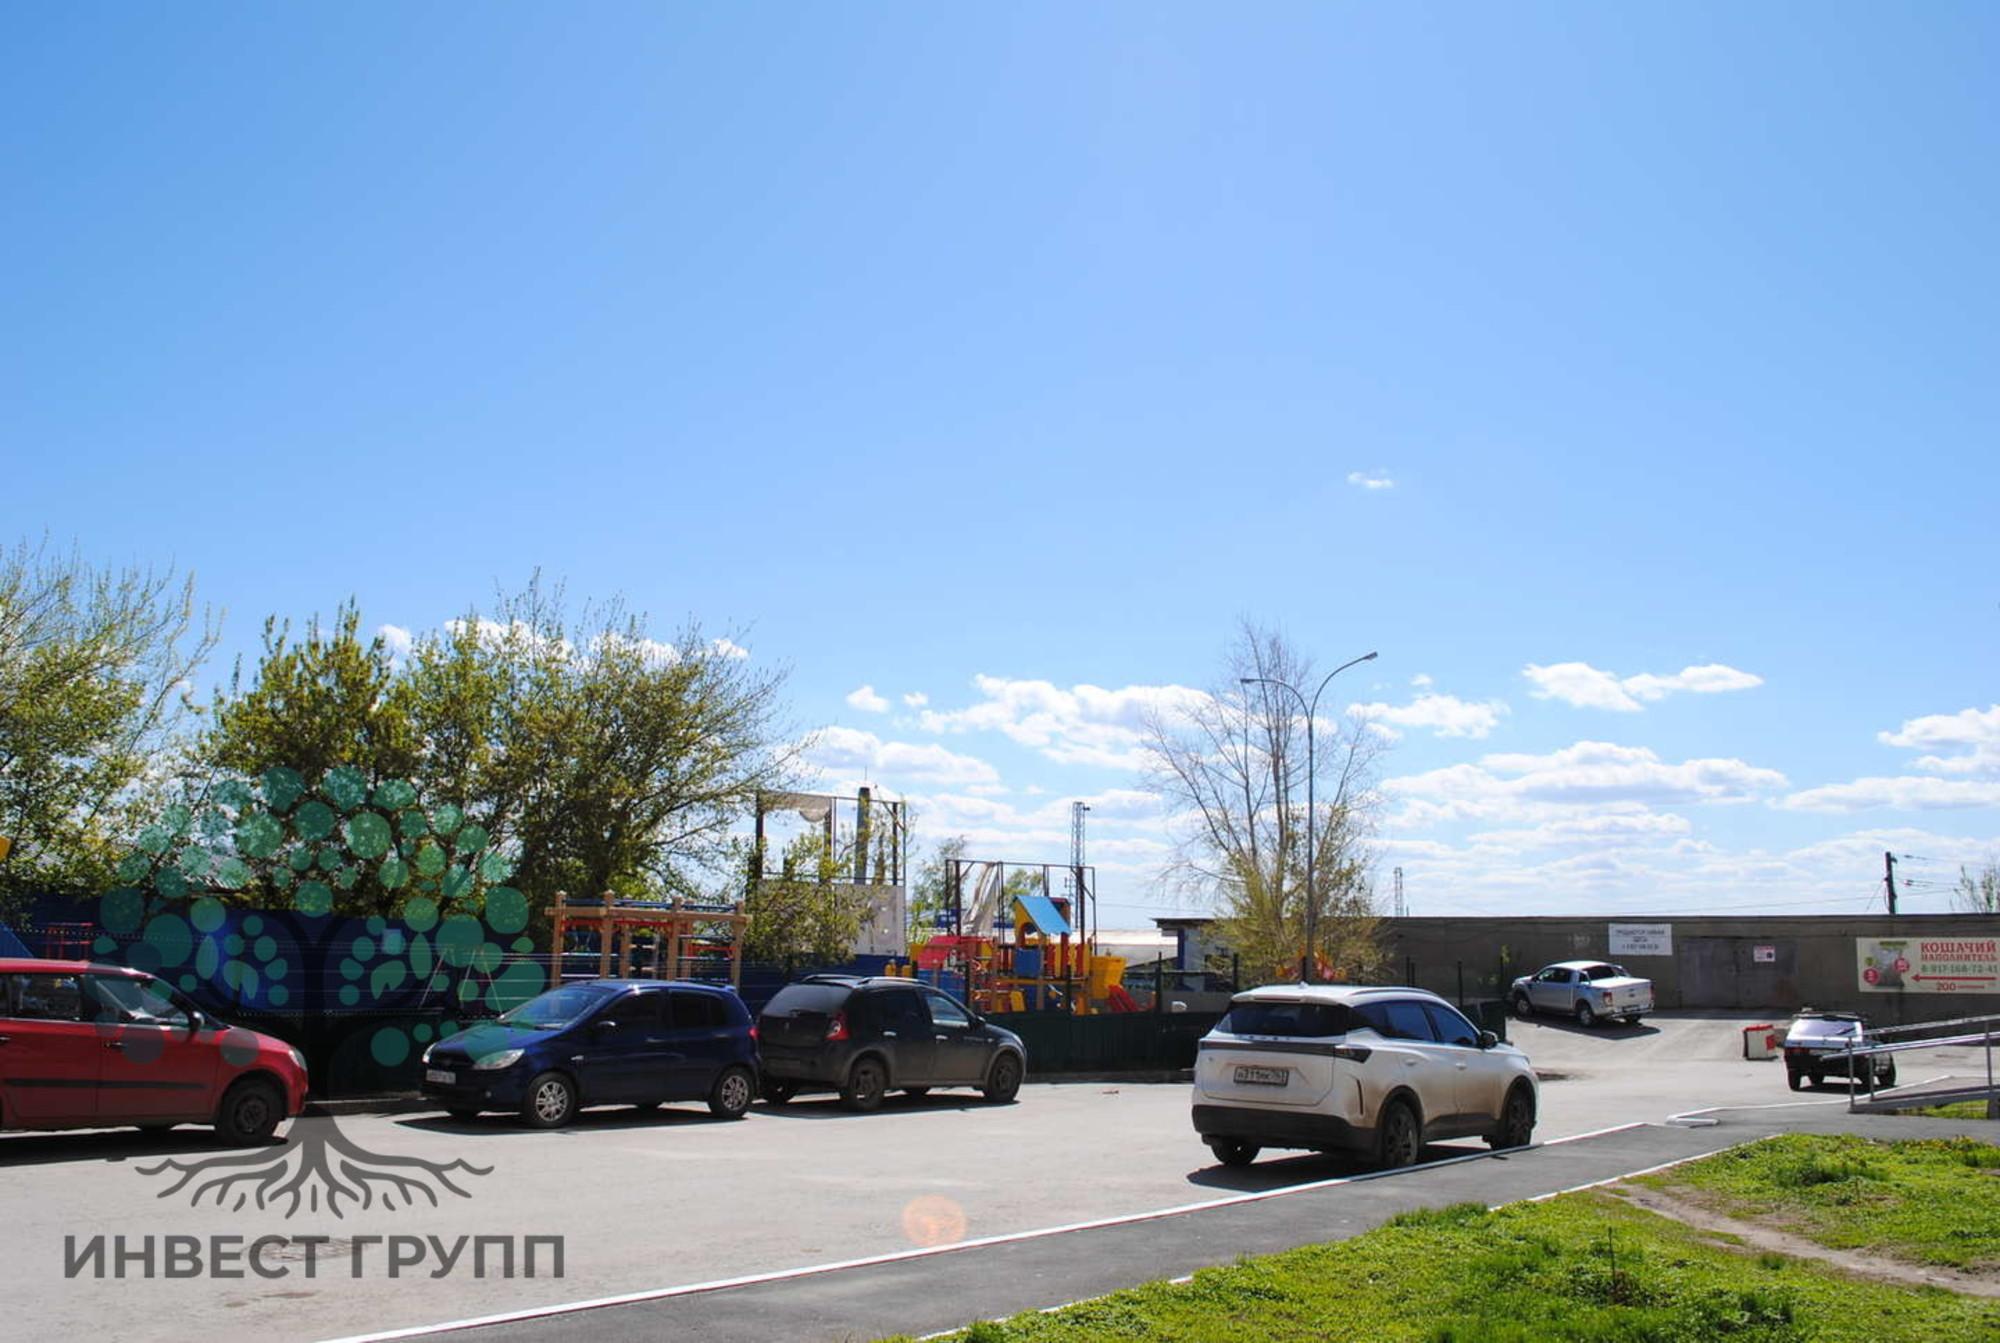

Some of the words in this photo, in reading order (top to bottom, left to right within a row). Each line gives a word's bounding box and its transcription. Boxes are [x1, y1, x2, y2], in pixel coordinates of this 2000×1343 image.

[1920, 940, 1997, 953] КОШАЧИЙ
[1920, 953, 1998, 962] НАПОЛНИТЕЛЬ
[1936, 982, 1957, 991] 200
